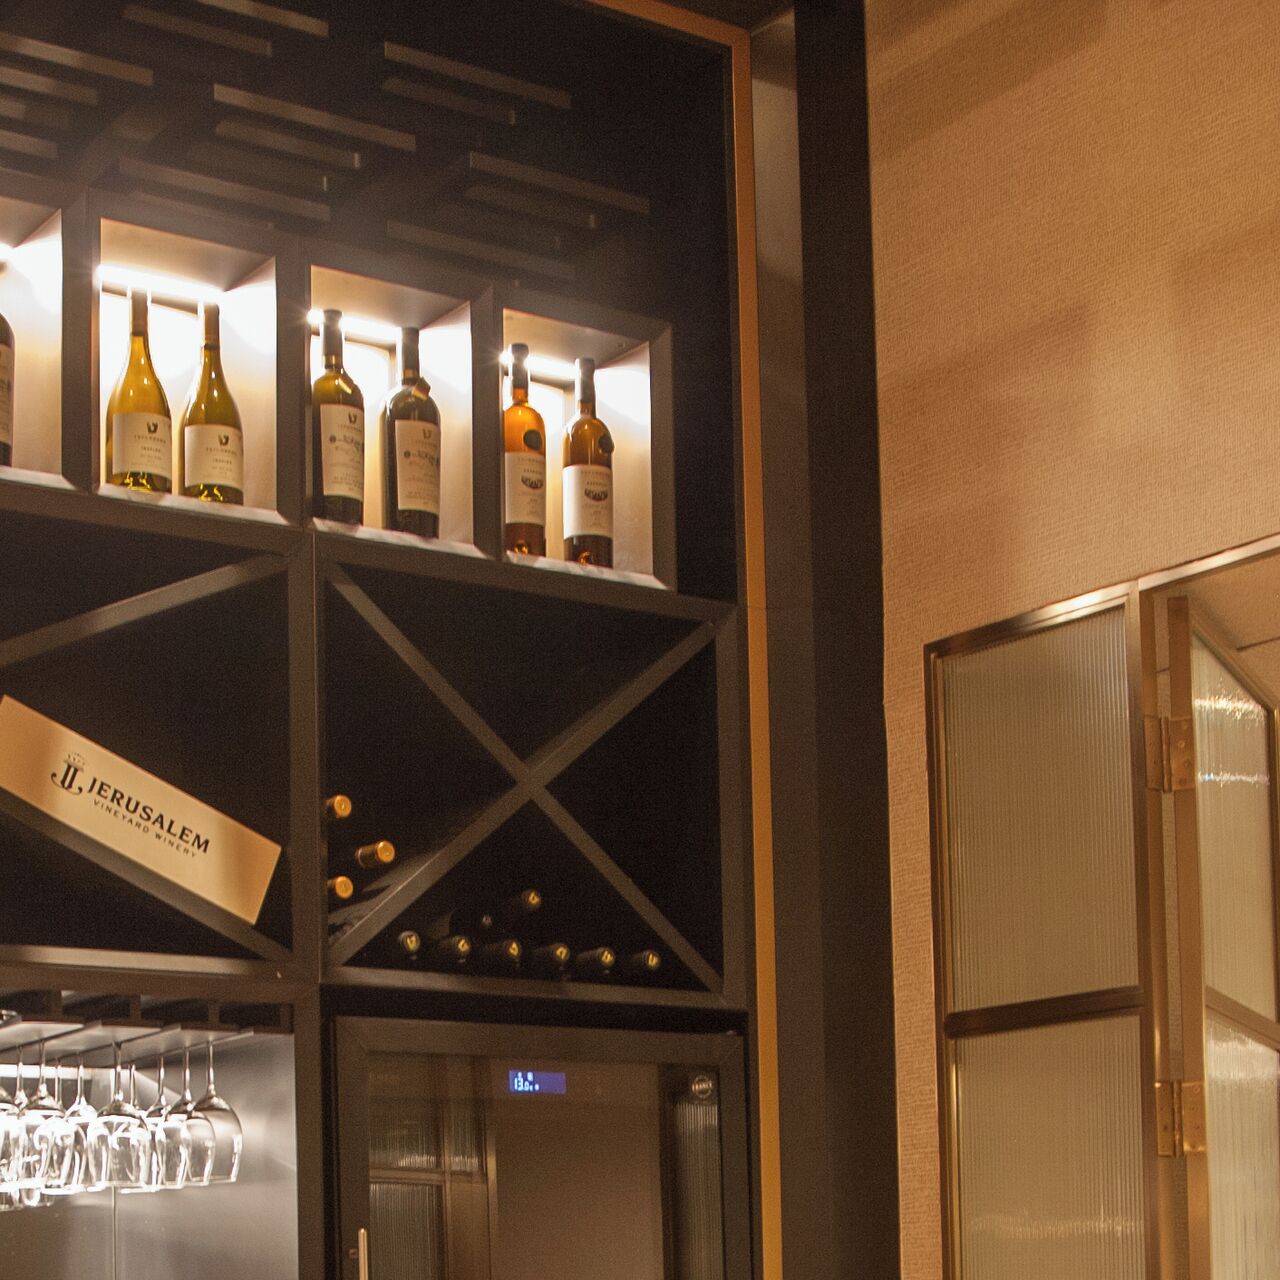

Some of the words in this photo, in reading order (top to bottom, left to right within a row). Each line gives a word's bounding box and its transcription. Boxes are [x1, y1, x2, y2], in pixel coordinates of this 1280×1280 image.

[87, 776, 211, 854] JERUSALEM
[93, 799, 150, 834] VINEYARD
[154, 832, 197, 859] WINERY
